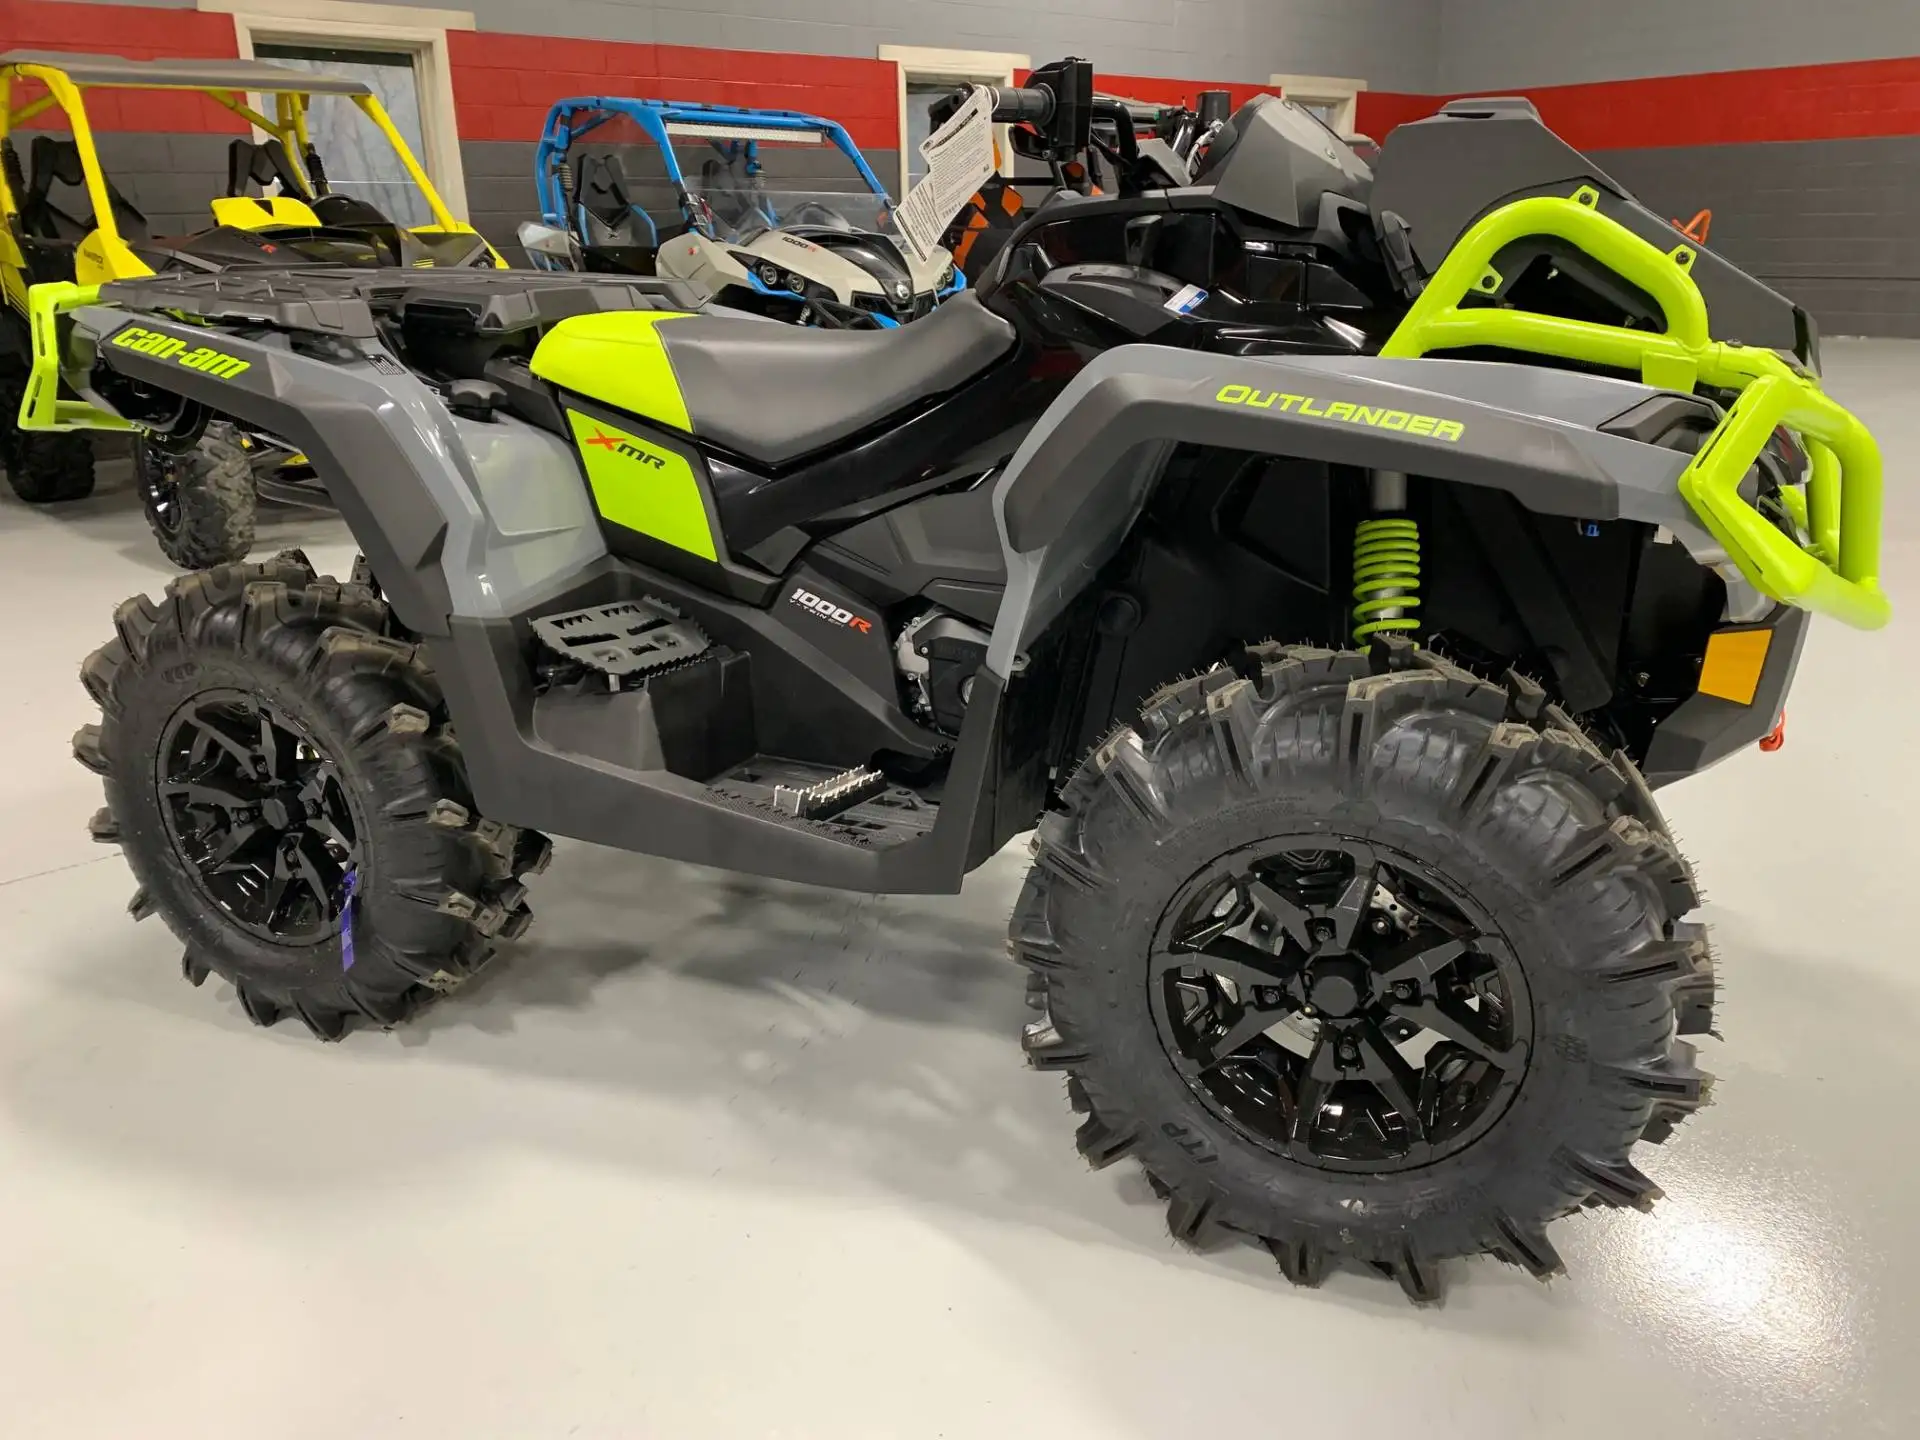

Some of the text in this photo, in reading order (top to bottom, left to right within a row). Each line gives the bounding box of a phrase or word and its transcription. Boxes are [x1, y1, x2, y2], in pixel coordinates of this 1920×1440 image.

[111, 327, 251, 379] can-am
[1215, 383, 1466, 442] OUTLANDER
[791, 587, 873, 635] 1000R
[1161, 1122, 1219, 1166] ITP
